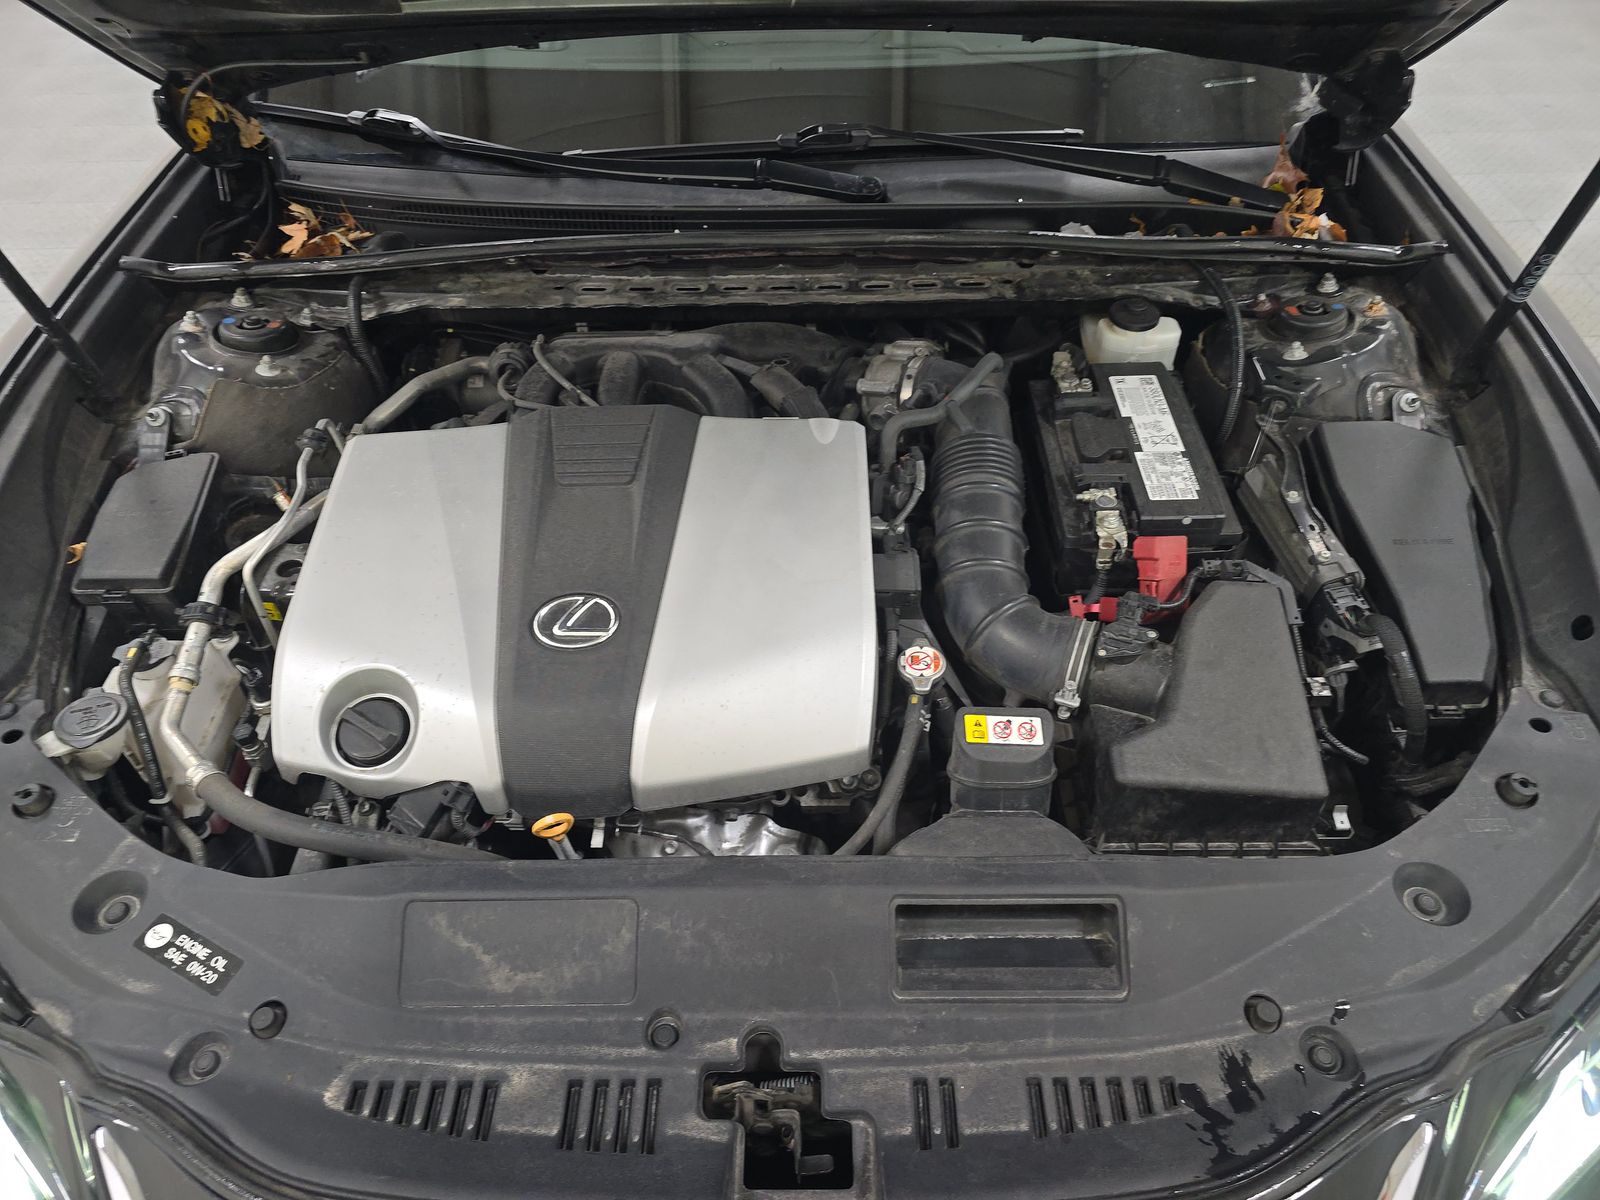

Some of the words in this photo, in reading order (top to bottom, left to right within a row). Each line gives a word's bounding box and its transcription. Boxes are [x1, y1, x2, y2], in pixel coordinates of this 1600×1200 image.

[164, 947, 188, 965] SAE
[174, 934, 212, 960] ENGINE
[210, 956, 228, 972] OIL
